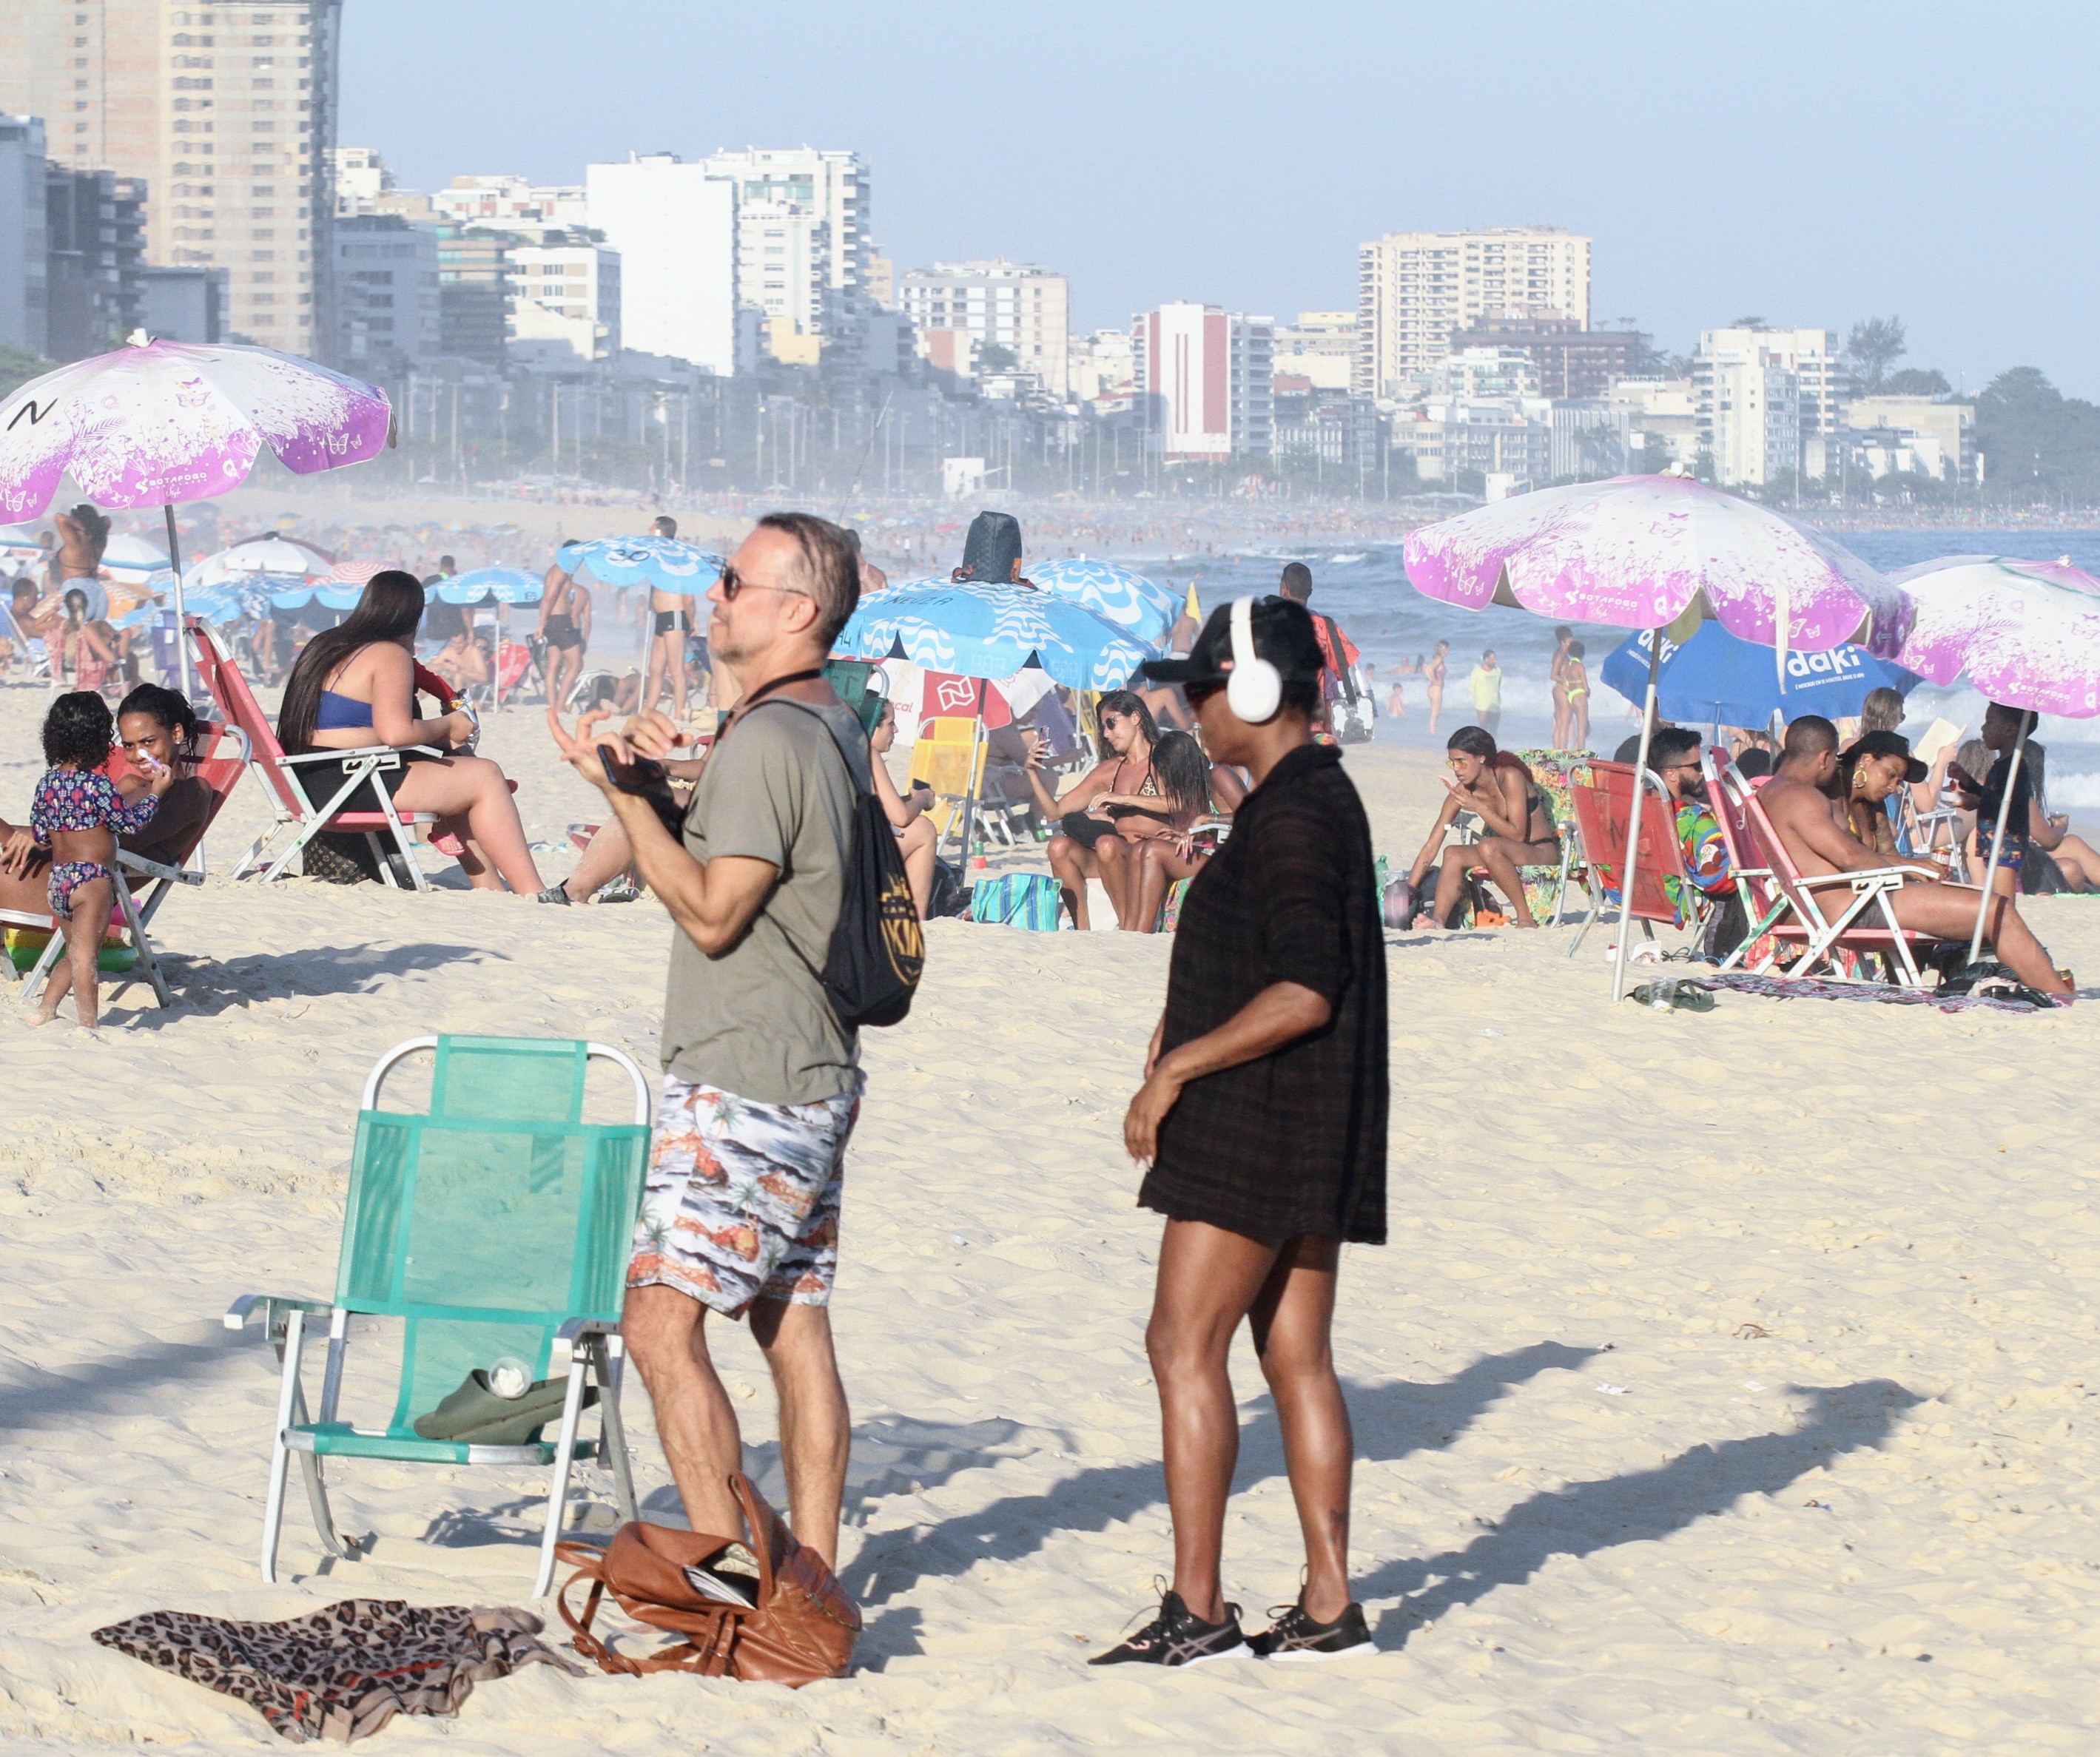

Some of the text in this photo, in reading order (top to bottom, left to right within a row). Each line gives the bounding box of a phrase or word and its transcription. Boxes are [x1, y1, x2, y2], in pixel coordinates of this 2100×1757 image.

[149, 472, 207, 486] BOTAFOGO
[884, 596, 954, 606] NEUZA
[1578, 593, 1638, 608] BOTAFOGO
[1787, 646, 1861, 677] daki
[2020, 684, 2070, 700] BOTAFOGO
